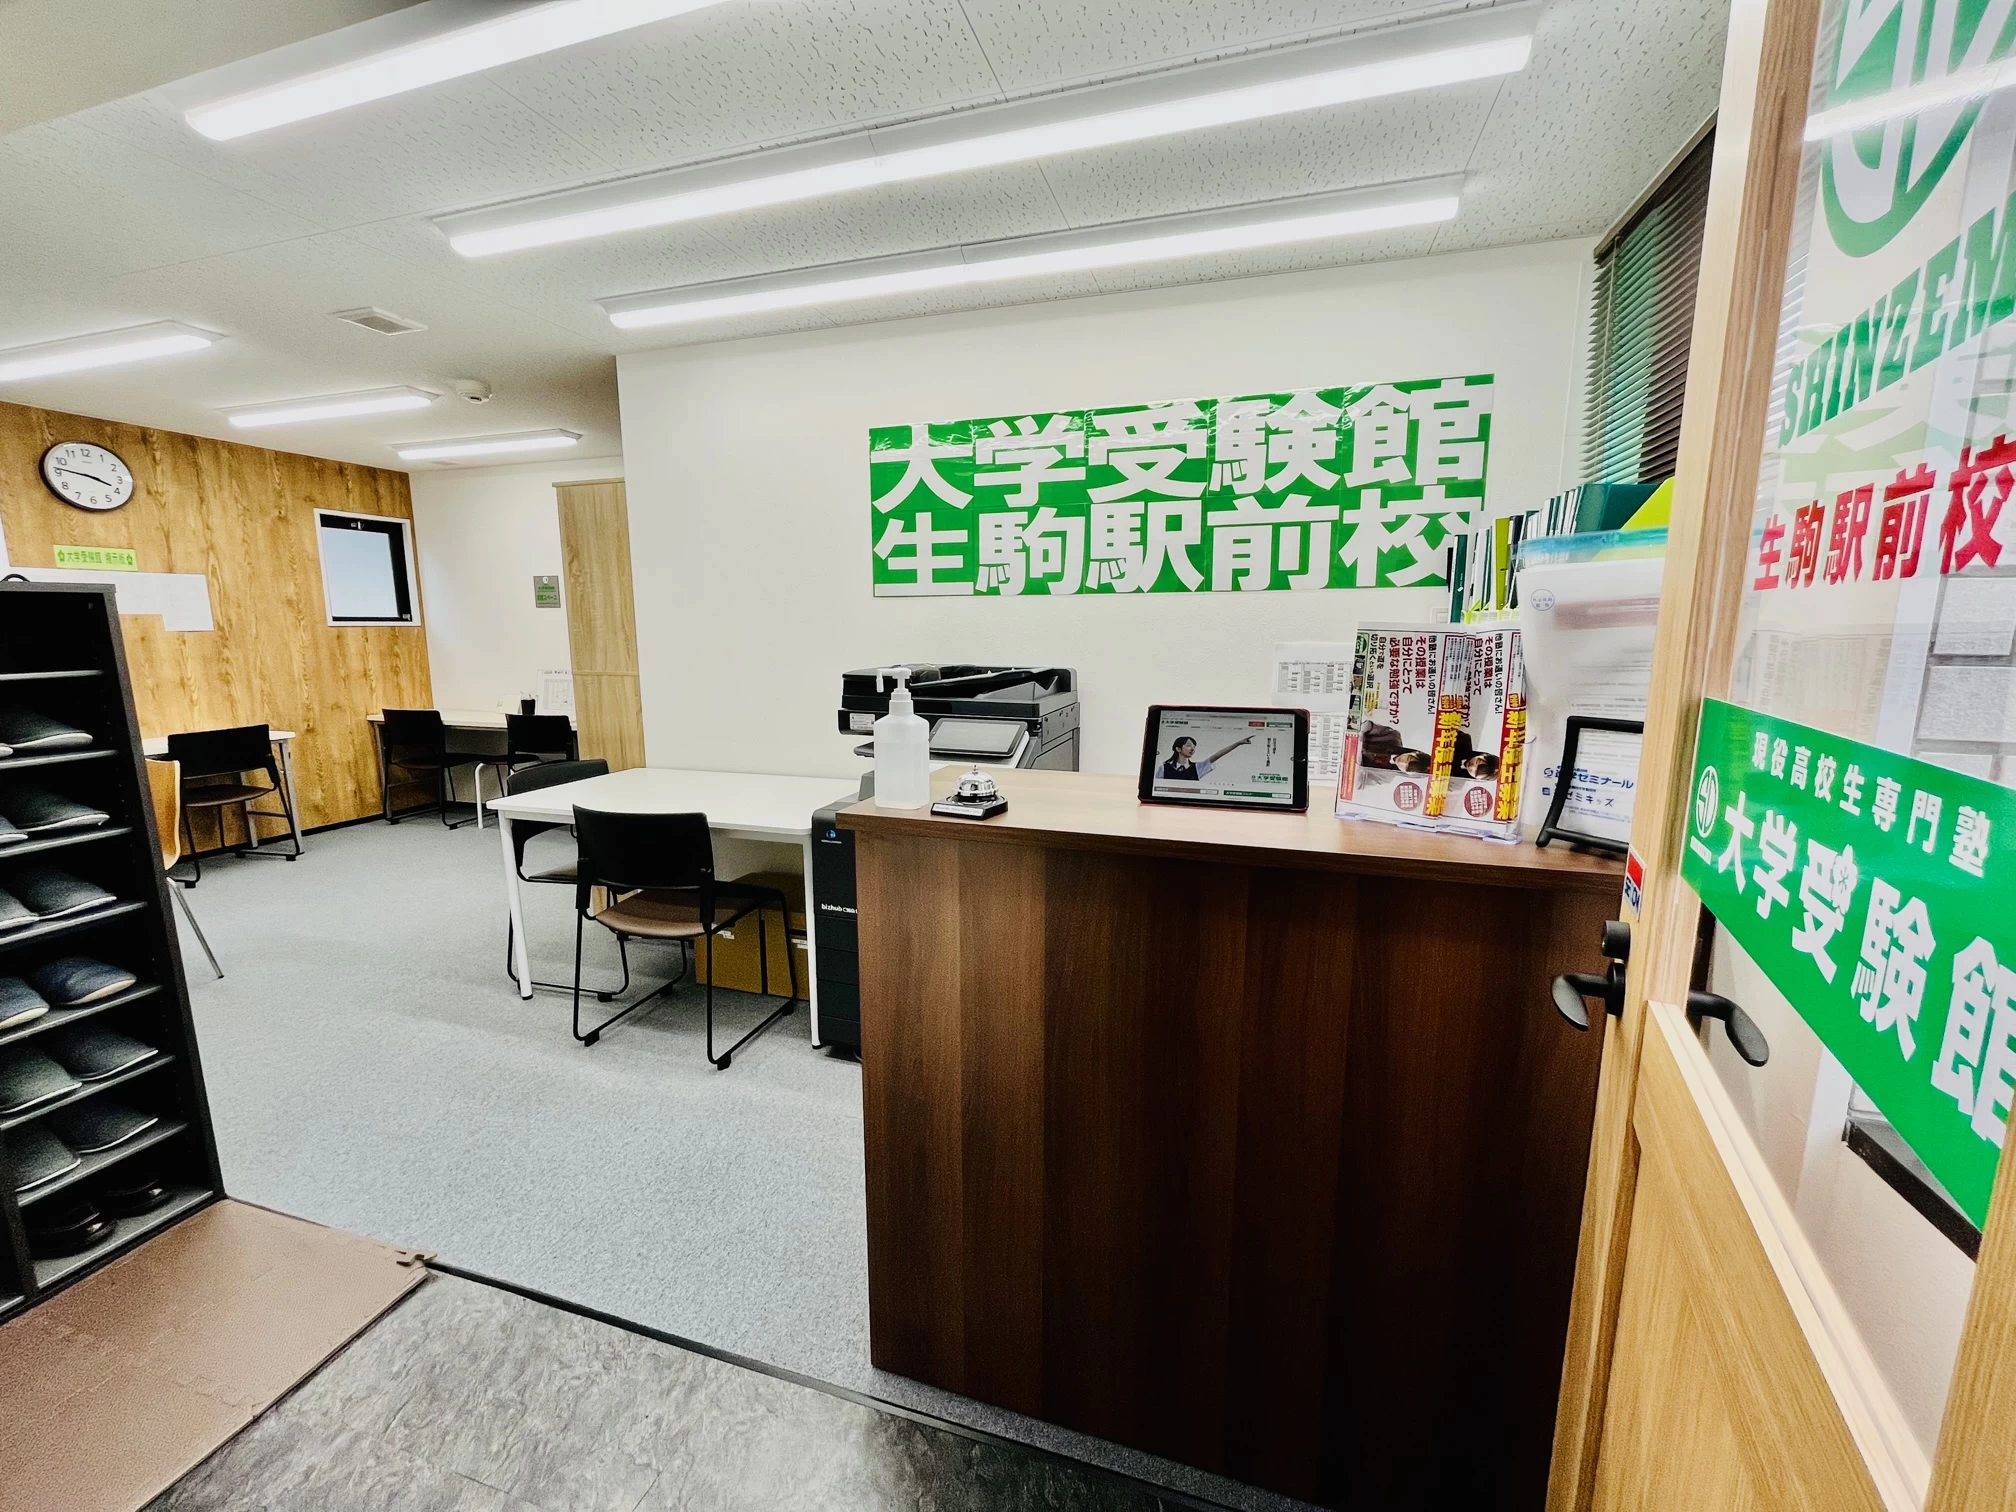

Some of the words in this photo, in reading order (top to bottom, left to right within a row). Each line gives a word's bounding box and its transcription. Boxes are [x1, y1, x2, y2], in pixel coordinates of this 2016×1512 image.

[871, 377, 1493, 513] 大学受験館
[65, 449, 76, 459] 11
[80, 448, 91, 458] 12
[99, 454, 105, 463] 1
[55, 457, 67, 466] 10
[110, 463, 117, 472] 2
[54, 468, 62, 477] 9
[116, 475, 123, 485] 3
[61, 481, 69, 490] 8
[113, 487, 121, 495] 4
[74, 491, 82, 500] 7
[90, 495, 98, 504] 6
[104, 494, 112, 503] 5
[1753, 433, 2016, 592] 生駒駅前校
[874, 485, 1483, 595] 生駒駅前校
[1402, 637, 1414, 695] 自分にとって
[1414, 636, 1427, 689] その授業は
[1473, 637, 1483, 696] 自分にとって
[1483, 636, 1494, 689] その授業は
[1389, 637, 1401, 725] 必要な勉強ですか?
[1427, 634, 1438, 715] 他塾にお通いの皆さん!
[1494, 633, 1504, 715] 他塾にお通いの皆さん!
[1554, 769, 1634, 789] ゼミナール
[1751, 730, 1990, 878] 現役高校生専門塾
[821, 903, 843, 912] bizhub
[1717, 788, 2016, 1151] 大学受験館
